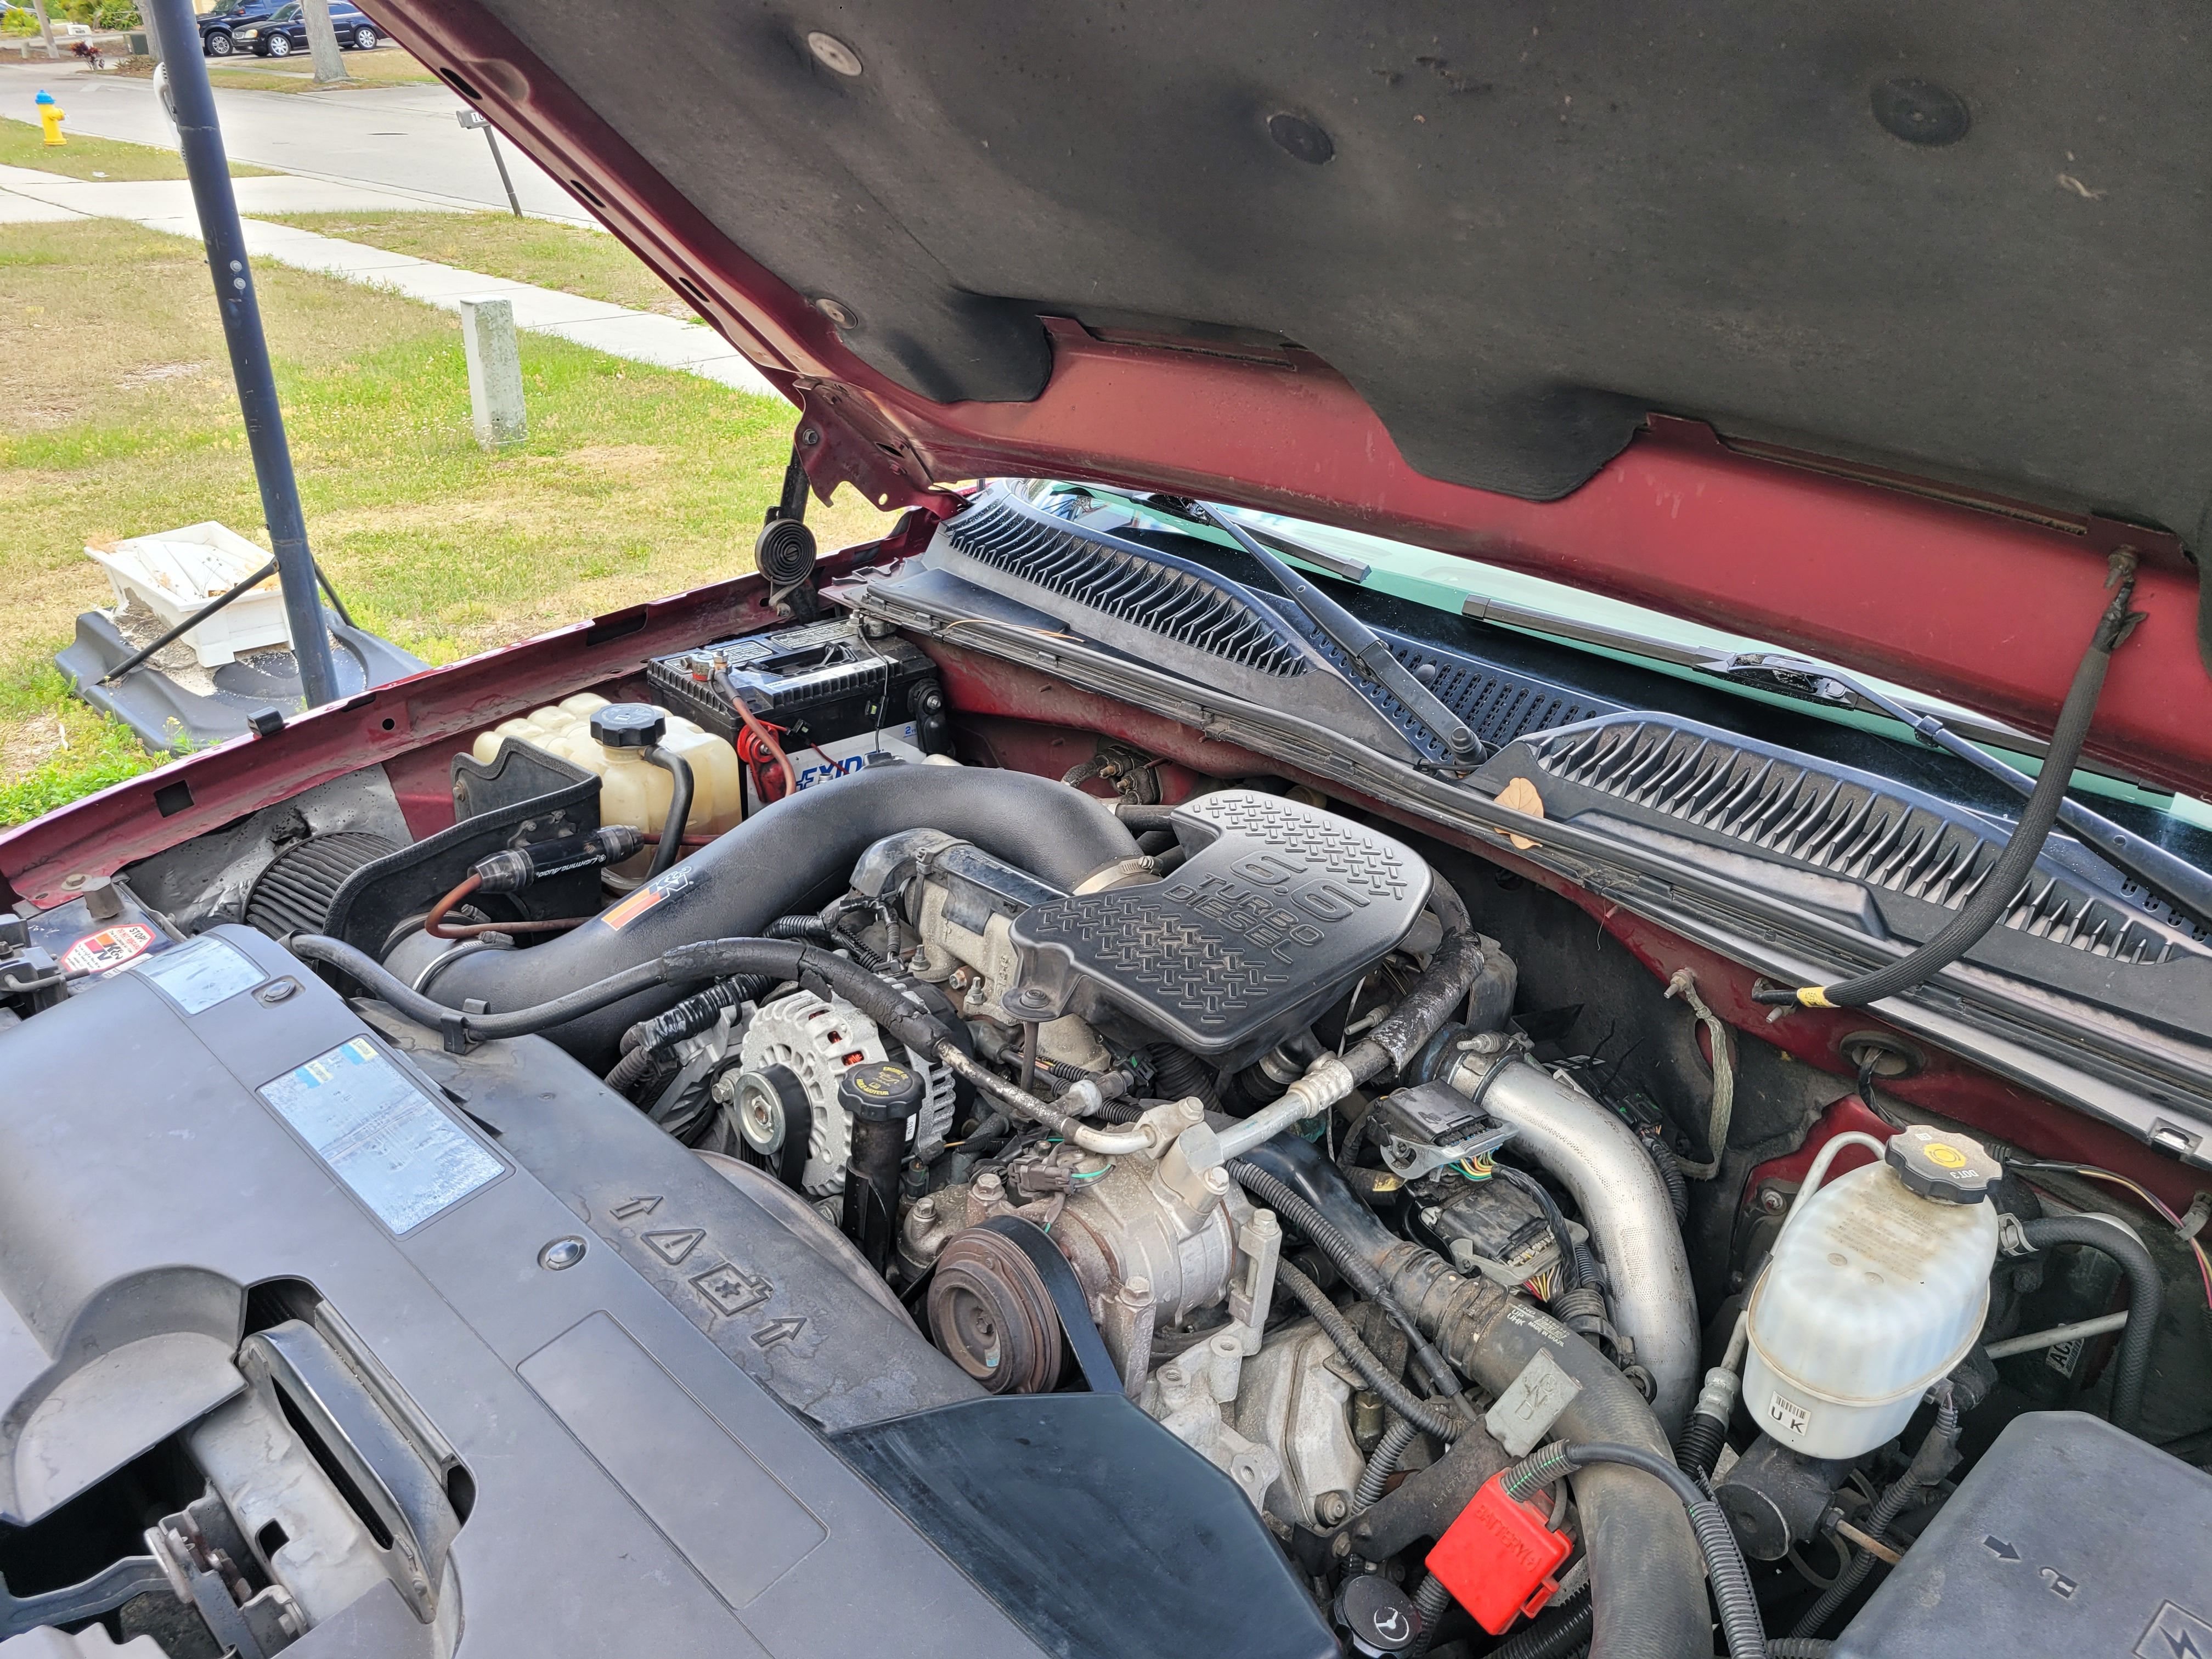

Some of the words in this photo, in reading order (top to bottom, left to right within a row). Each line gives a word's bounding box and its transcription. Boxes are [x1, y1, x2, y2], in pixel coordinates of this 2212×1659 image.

[905, 726, 911, 735] 2
[796, 750, 881, 791] EXID
[1230, 850, 1371, 922] 6.6
[1198, 873, 1324, 946] TURBO
[122, 932, 130, 940] NOT
[129, 927, 148, 943] STOP!
[1163, 883, 1293, 965] DIESEL
[883, 1066, 904, 1075] ENGINE
[1507, 1313, 1525, 1327] UHK
[1511, 1309, 1524, 1318] UP
[1528, 1321, 1543, 1333] MADE
[1548, 1334, 1565, 1347] BRAZIL
[2050, 1342, 2073, 1368] AC
[1771, 1406, 1783, 1420] U
[1790, 1418, 1805, 1434] K
